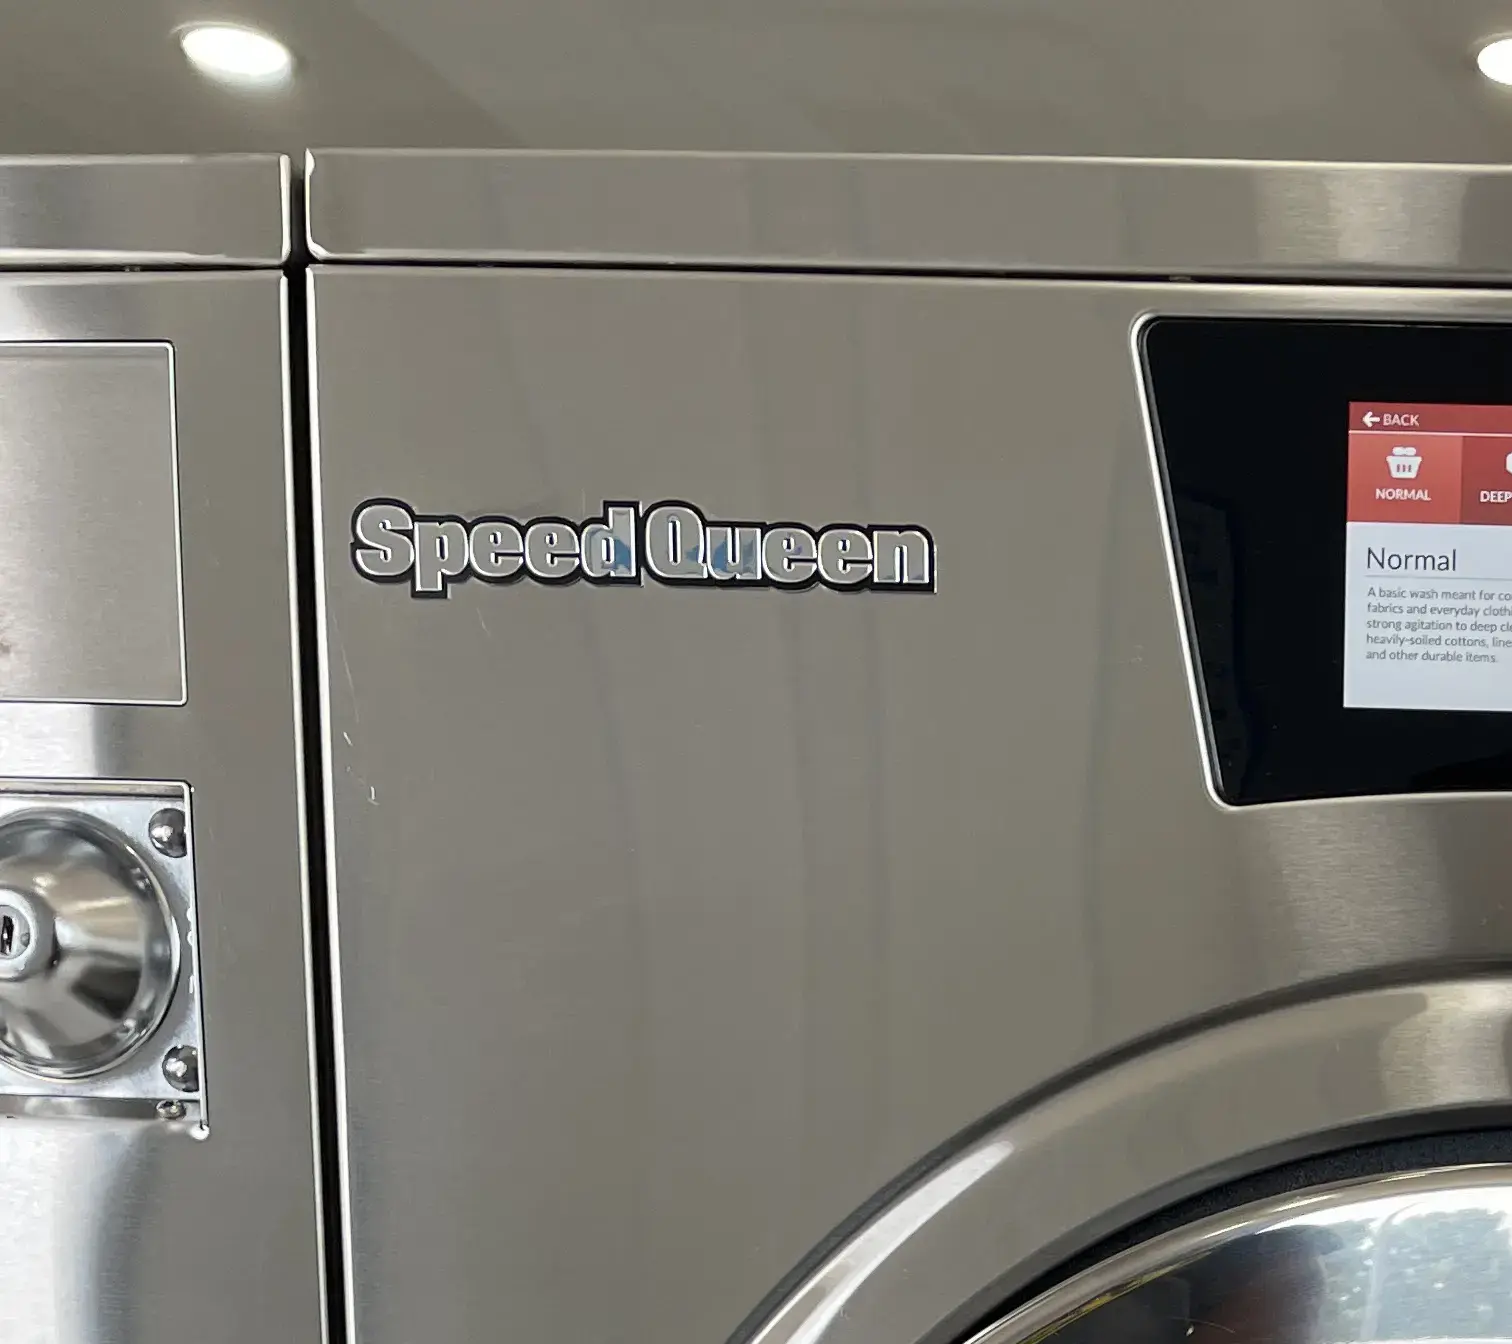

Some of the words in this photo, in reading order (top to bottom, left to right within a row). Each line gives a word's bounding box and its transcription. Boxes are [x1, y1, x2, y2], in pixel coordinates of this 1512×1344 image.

[1383, 414, 1420, 426] BACK
[1376, 488, 1431, 501] NORMAL
[1480, 490, 1512, 503] DEEP
[351, 498, 642, 599] Speed
[640, 500, 936, 594] Queen
[1367, 546, 1457, 572] Normal
[1368, 586, 1376, 597] A
[1379, 587, 1407, 598] basic
[1410, 589, 1438, 599] wash
[1441, 590, 1476, 600] meant
[1479, 590, 1496, 600] for
[1367, 602, 1404, 613] fabrics
[1406, 604, 1427, 614] and
[1430, 605, 1480, 618] everyday
[1366, 620, 1401, 631] strong
[1404, 620, 1452, 632] agitation
[1456, 621, 1467, 630] to
[1470, 620, 1497, 633] deep
[1366, 633, 1442, 647] heavily-soiled
[1444, 637, 1489, 648] cottons,
[1366, 649, 1386, 660] and
[1389, 650, 1418, 660] other
[1421, 650, 1463, 661] durable
[1466, 652, 1498, 663] items.
